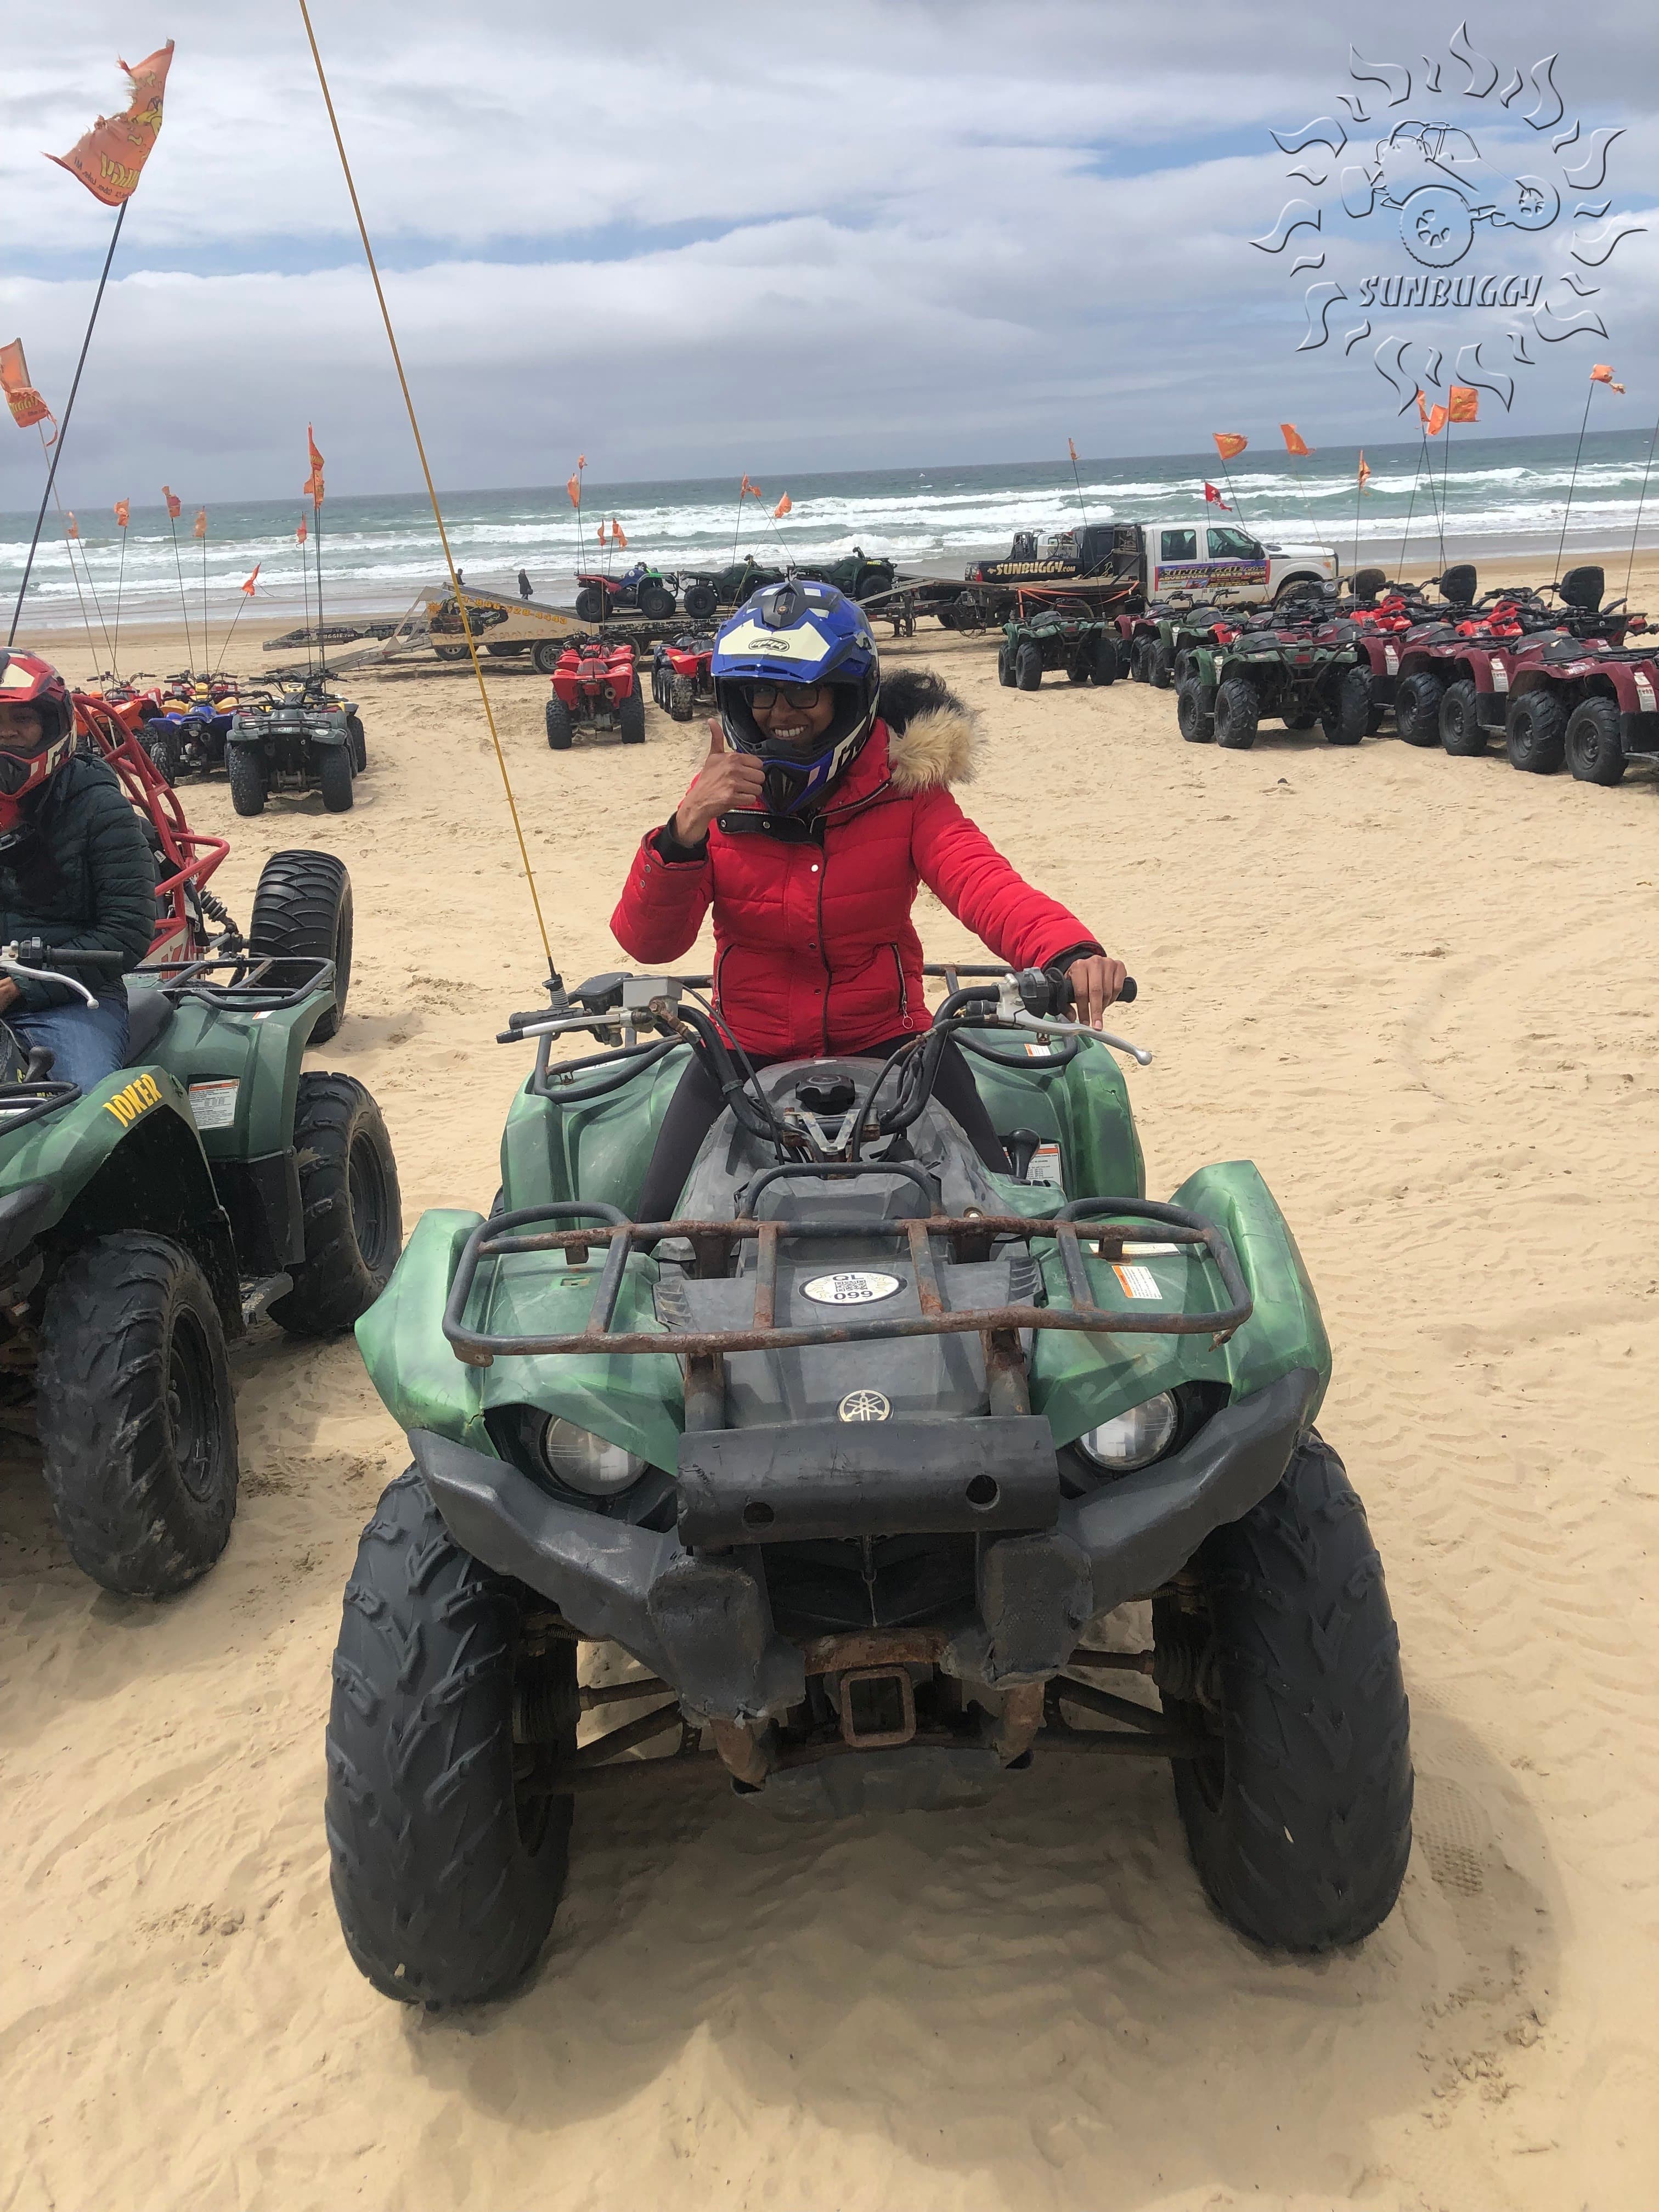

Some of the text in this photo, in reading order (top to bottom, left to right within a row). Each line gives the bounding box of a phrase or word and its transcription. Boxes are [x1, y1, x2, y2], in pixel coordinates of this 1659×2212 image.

[996, 561, 1076, 575] SUNBUGGY.COM
[102, 1073, 162, 1128] JOKER
[833, 1290, 873, 1300] 099
